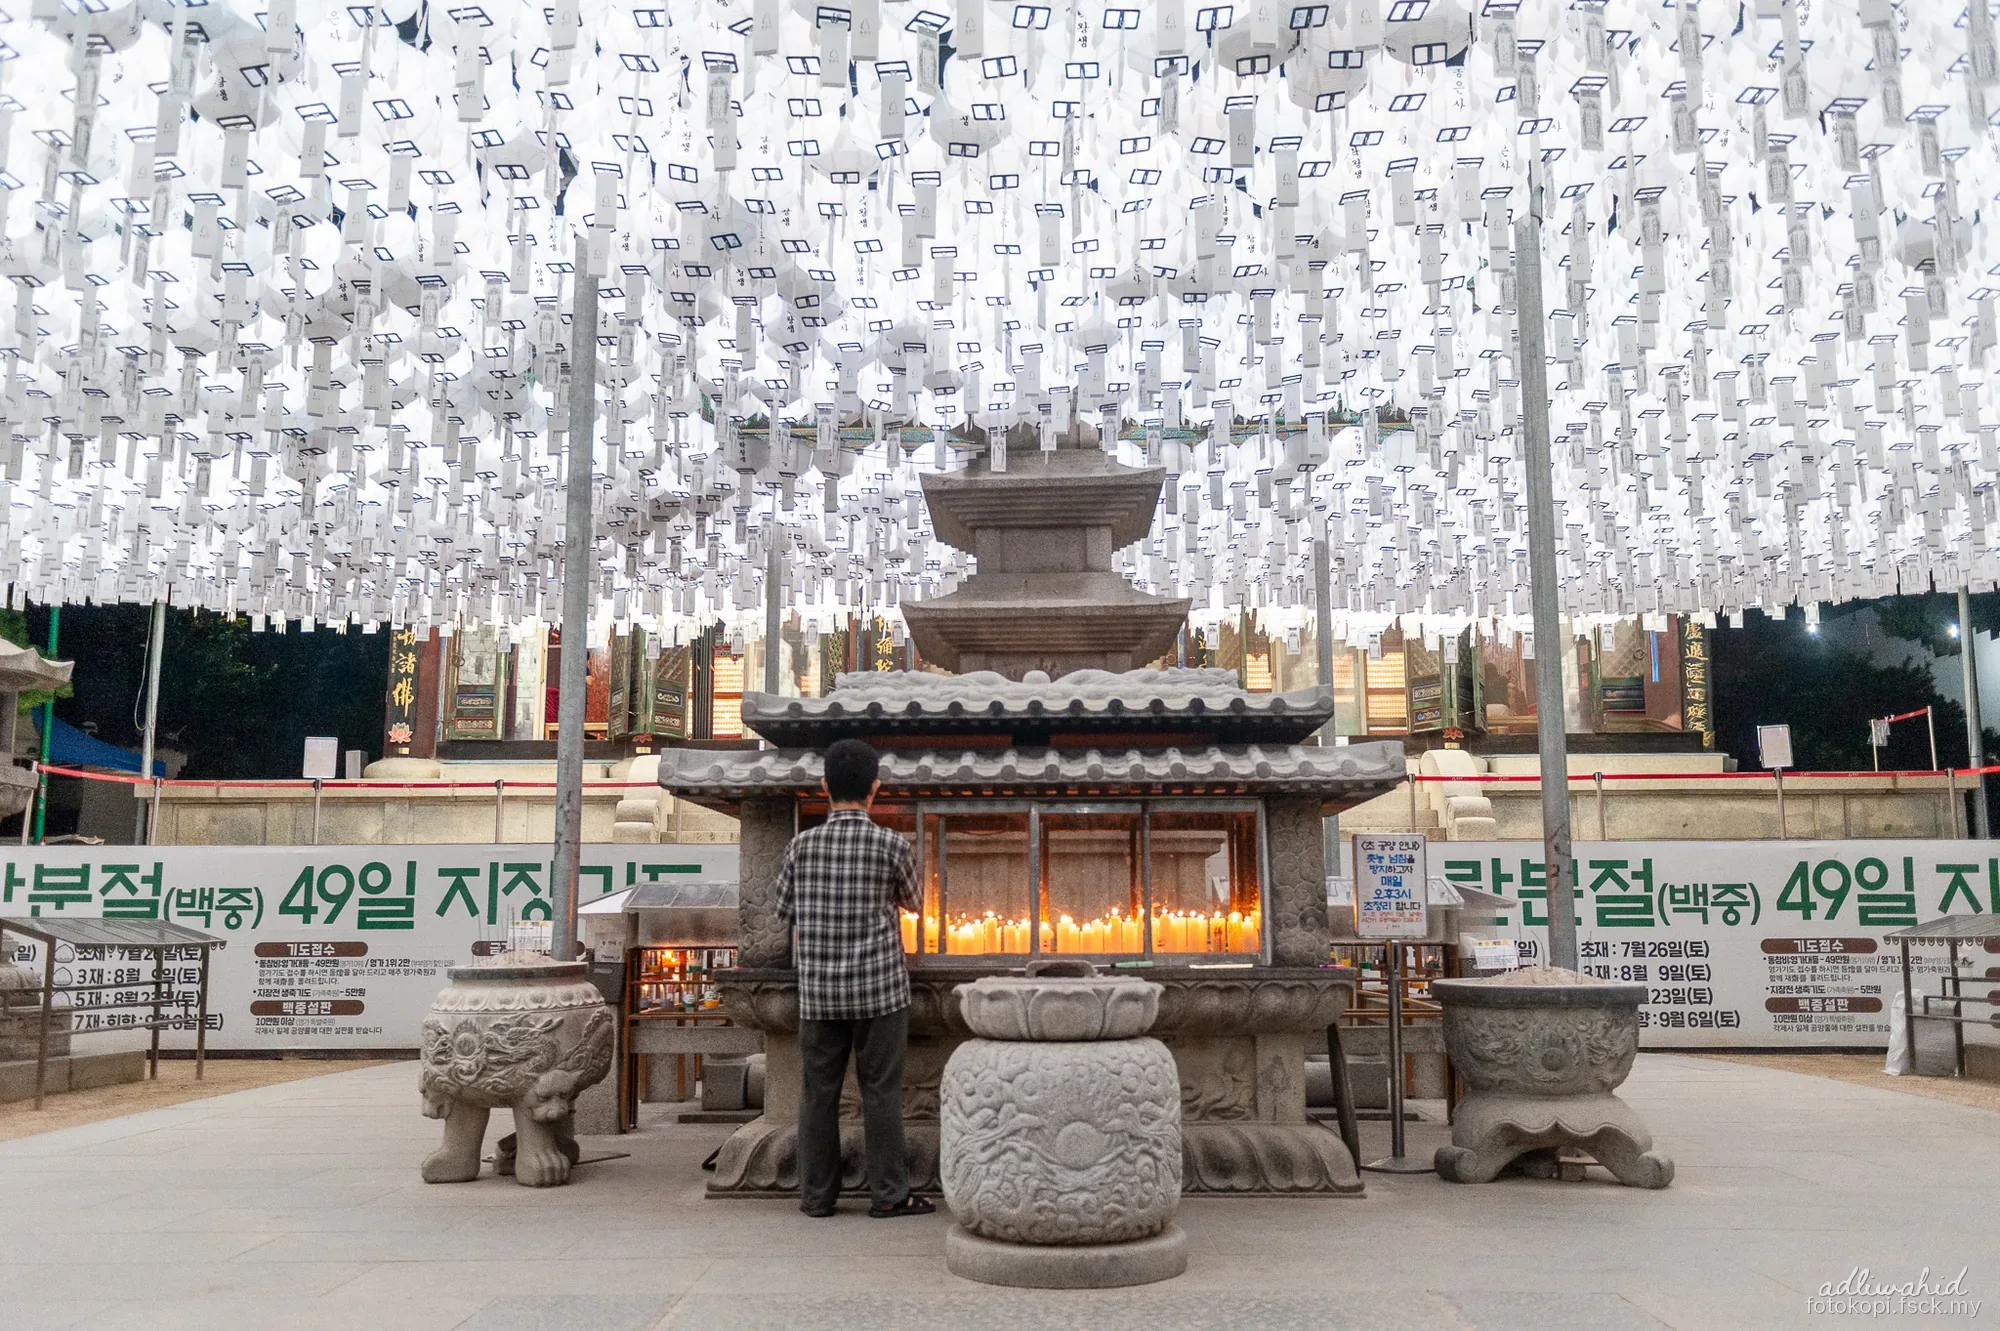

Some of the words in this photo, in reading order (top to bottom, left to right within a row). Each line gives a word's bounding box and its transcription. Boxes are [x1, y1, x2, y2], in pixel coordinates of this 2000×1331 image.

[1378, 840, 1396, 851] 공양
[1369, 865, 1413, 874] 방지하고자
[1381, 876, 1402, 887] 매일
[279, 861, 417, 930] 49일
[1373, 889, 1411, 900] 오후3시
[1776, 857, 1918, 927] 49일
[1395, 901, 1421, 911] 합니다
[287, 943, 336, 957] 기도접수
[1794, 940, 1843, 953] 기도접수
[366, 969, 387, 977] 드리고
[257, 988, 280, 998] 지장전
[345, 988, 366, 997] 5만원
[1770, 985, 1794, 995] 지장전
[1860, 985, 1882, 994] 5만원
[1650, 987, 1714, 1006] 23일(토)
[282, 1001, 332, 1015] 백중설판
[1798, 998, 1849, 1012] 백중설판
[256, 1018, 280, 1026] 10만원
[1773, 1015, 1798, 1023] 10만원
[1799, 1015, 1813, 1023] 이상
